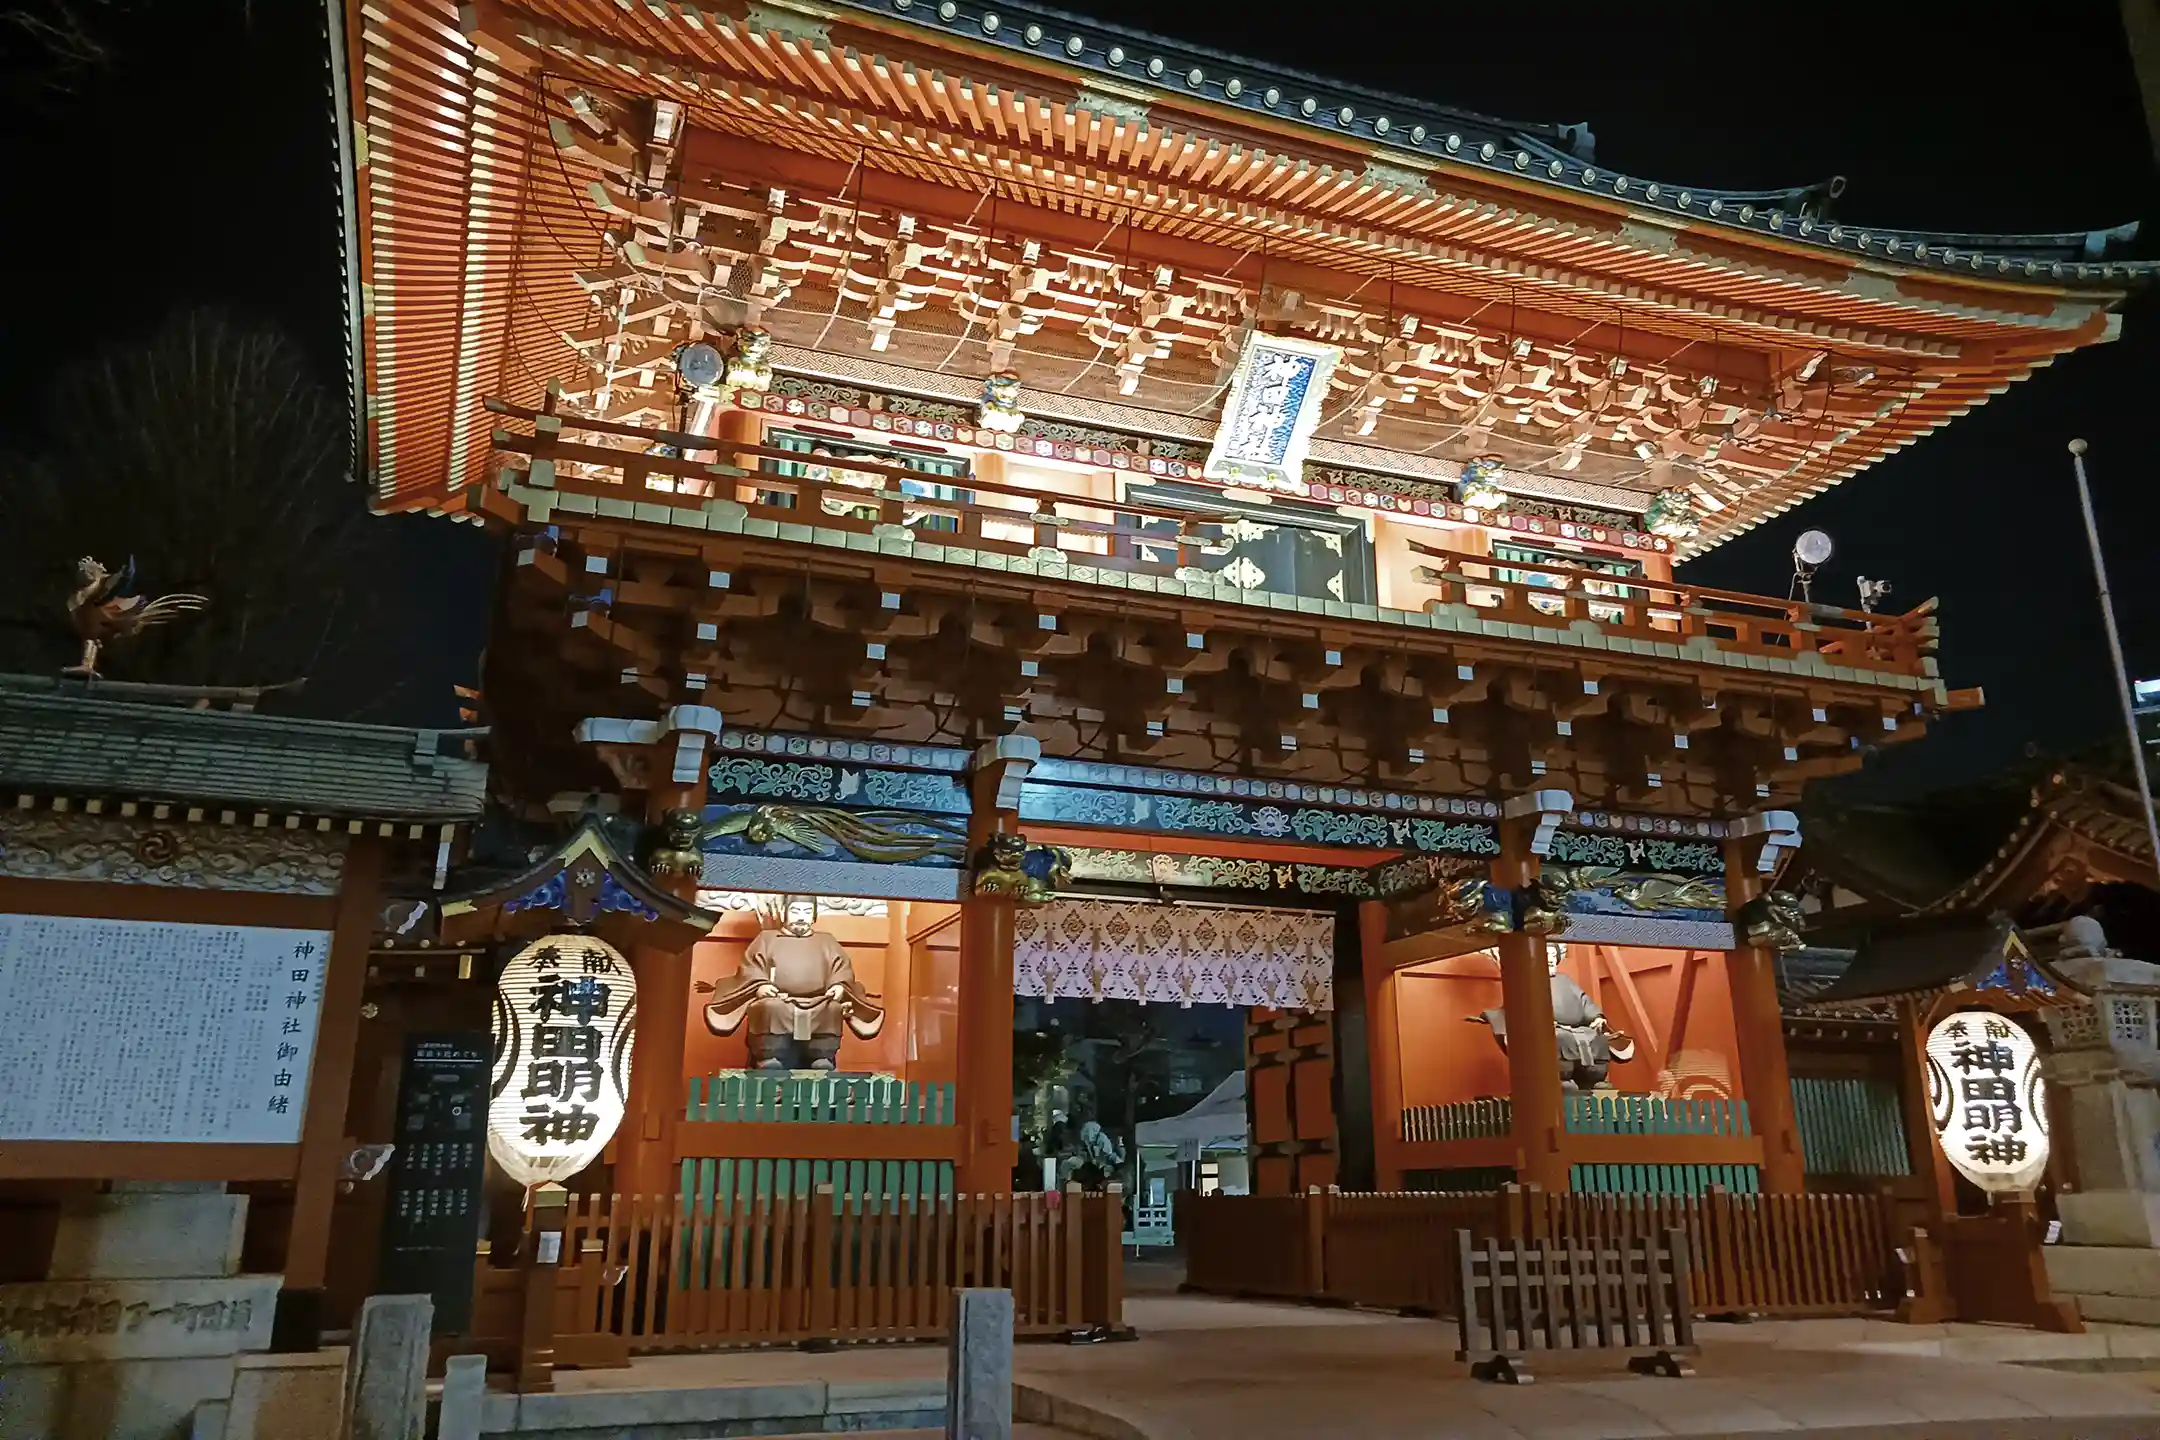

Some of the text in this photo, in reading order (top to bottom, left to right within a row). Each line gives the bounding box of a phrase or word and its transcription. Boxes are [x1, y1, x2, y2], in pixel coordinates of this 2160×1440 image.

[267, 940, 314, 1115] 神田神社御由緒
[519, 973, 612, 1145] 神田明神
[1949, 1040, 2028, 1165] 神田明神
